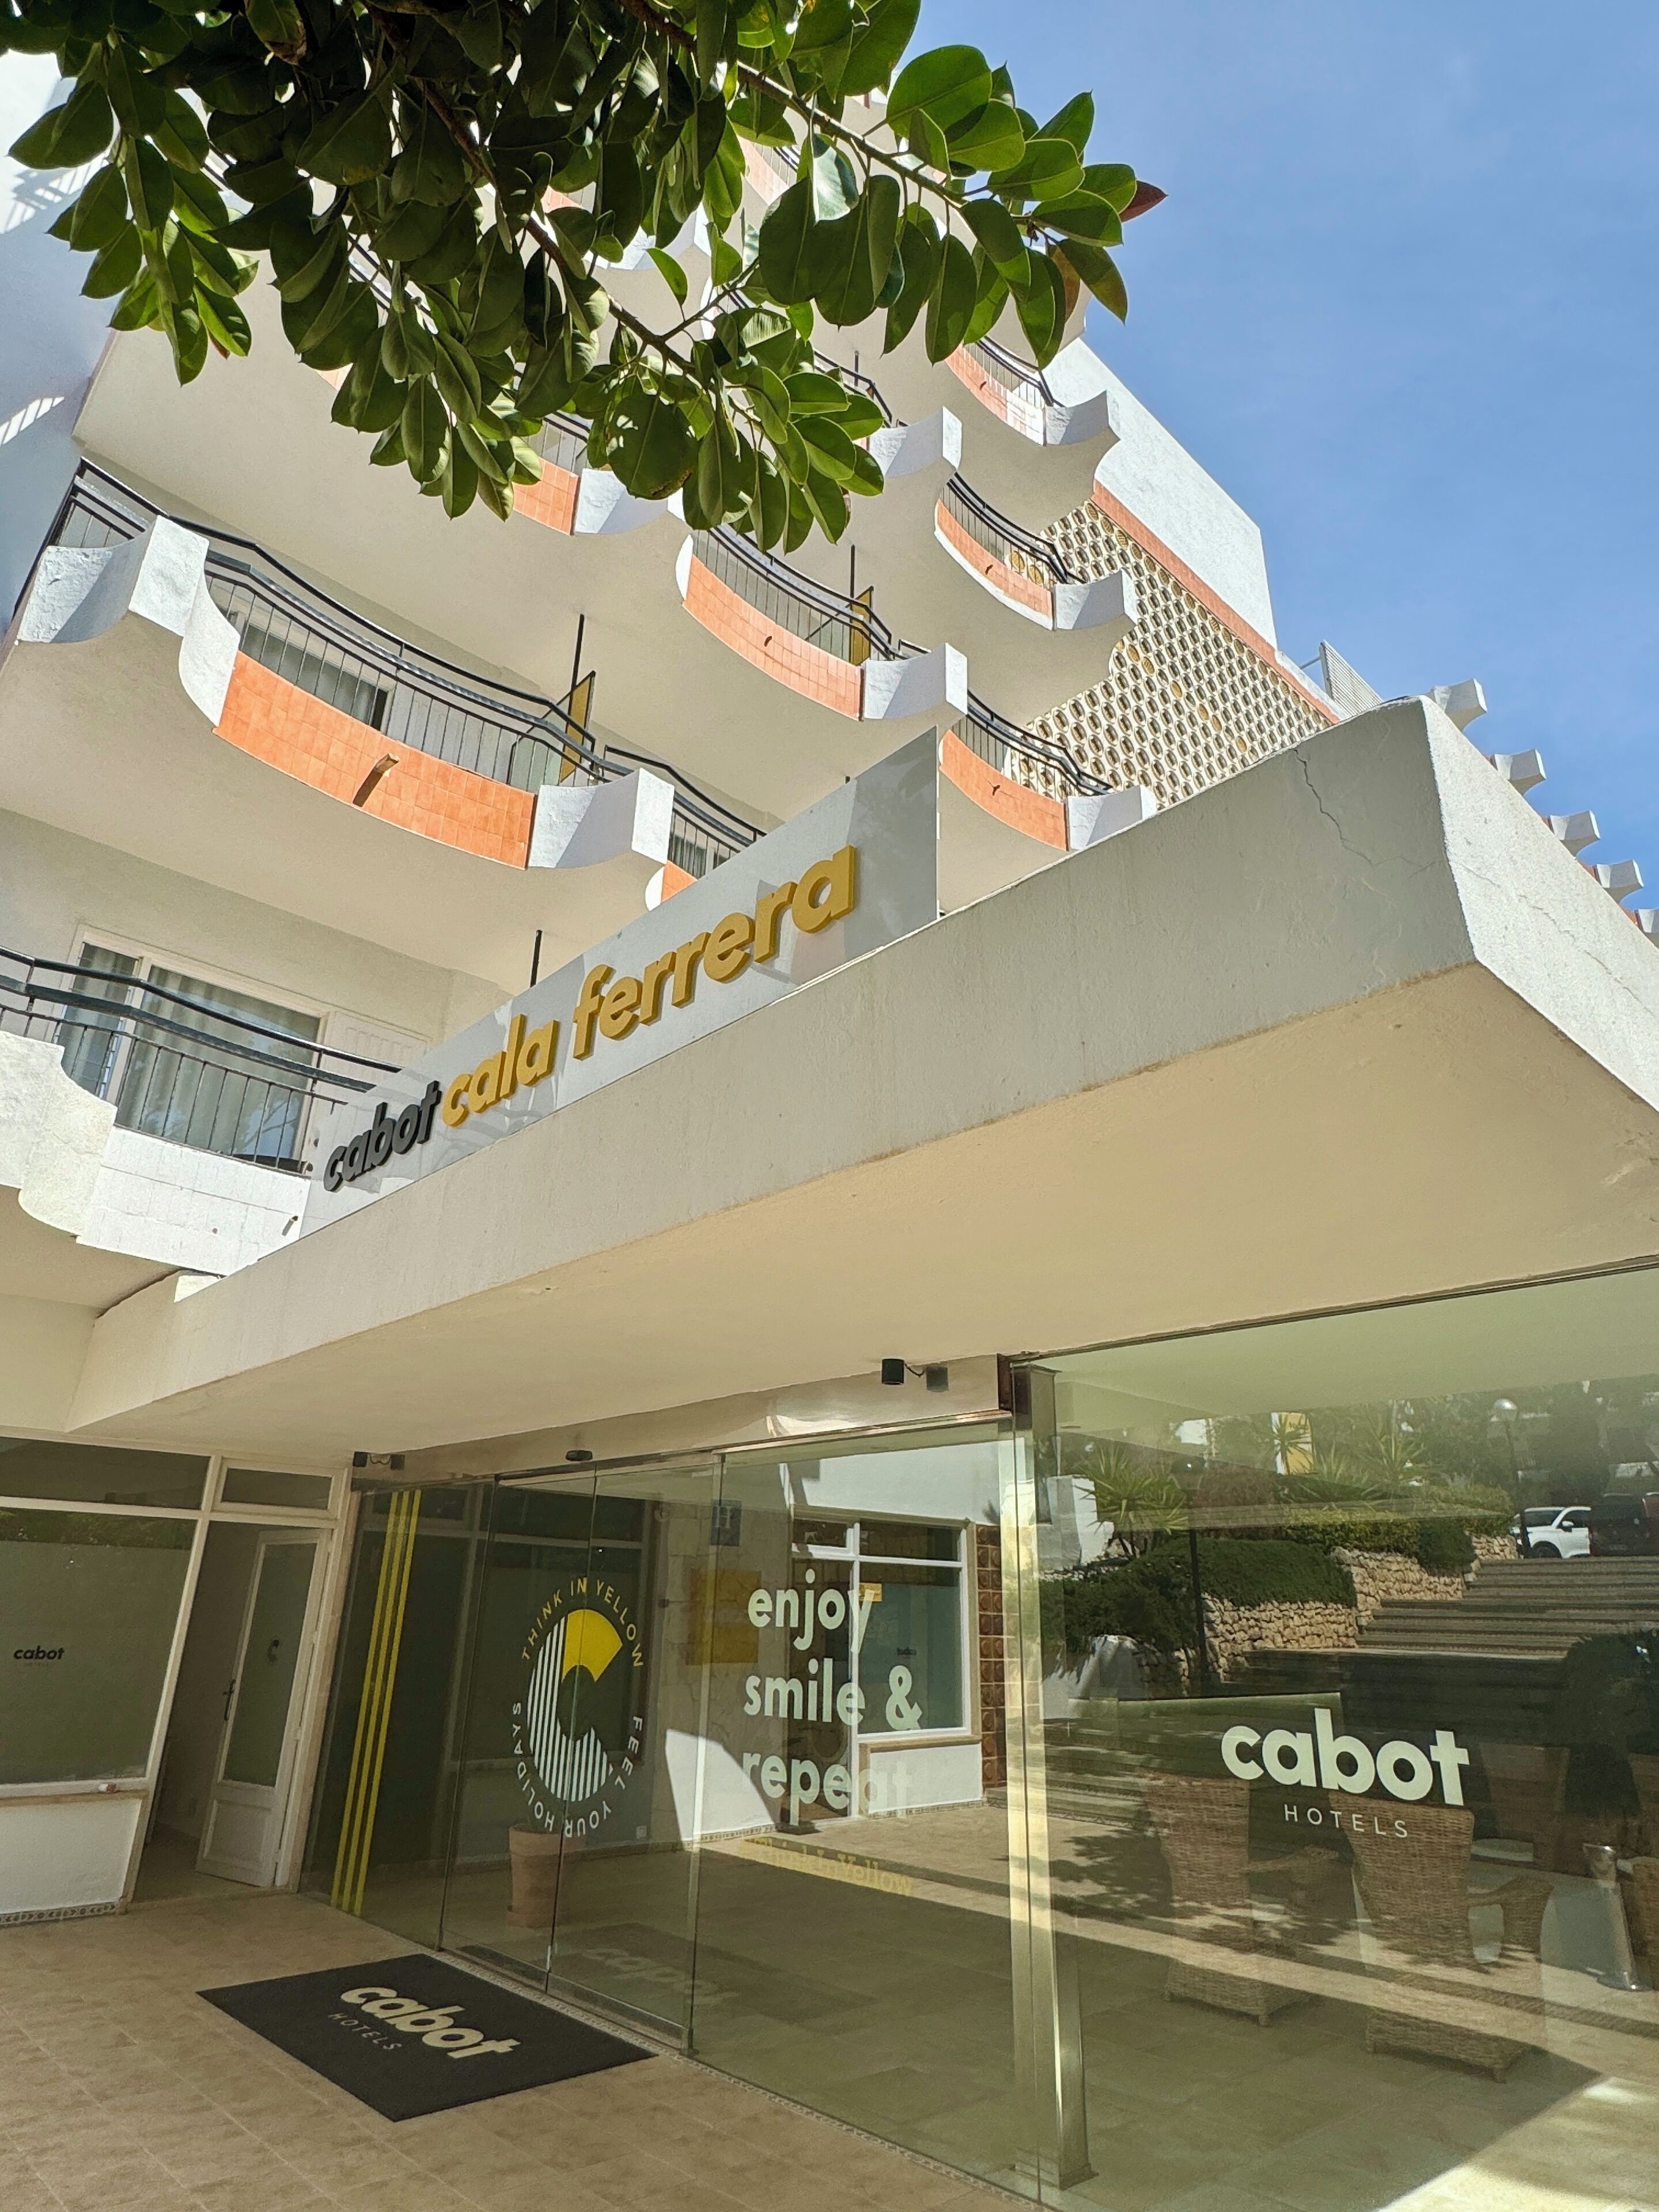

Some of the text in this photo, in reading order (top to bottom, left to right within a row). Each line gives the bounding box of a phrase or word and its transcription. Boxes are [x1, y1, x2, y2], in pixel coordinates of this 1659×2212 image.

[323, 845, 855, 1192] cabot cala ferrera
[522, 1577, 644, 1668] THINK IN YELLOW
[748, 1569, 874, 1653] enjoy
[14, 1645, 65, 1660] cabot
[744, 1658, 922, 1730] smile &
[513, 1702, 643, 1838] FEEL YOUR HOLIDAYS
[743, 1753, 911, 1826] repeat
[1221, 1708, 1469, 1805] cabot
[1285, 1804, 1408, 1838] HOTELS
[328, 2013, 402, 2050] HOTELS
[340, 1987, 521, 2059] cabot
